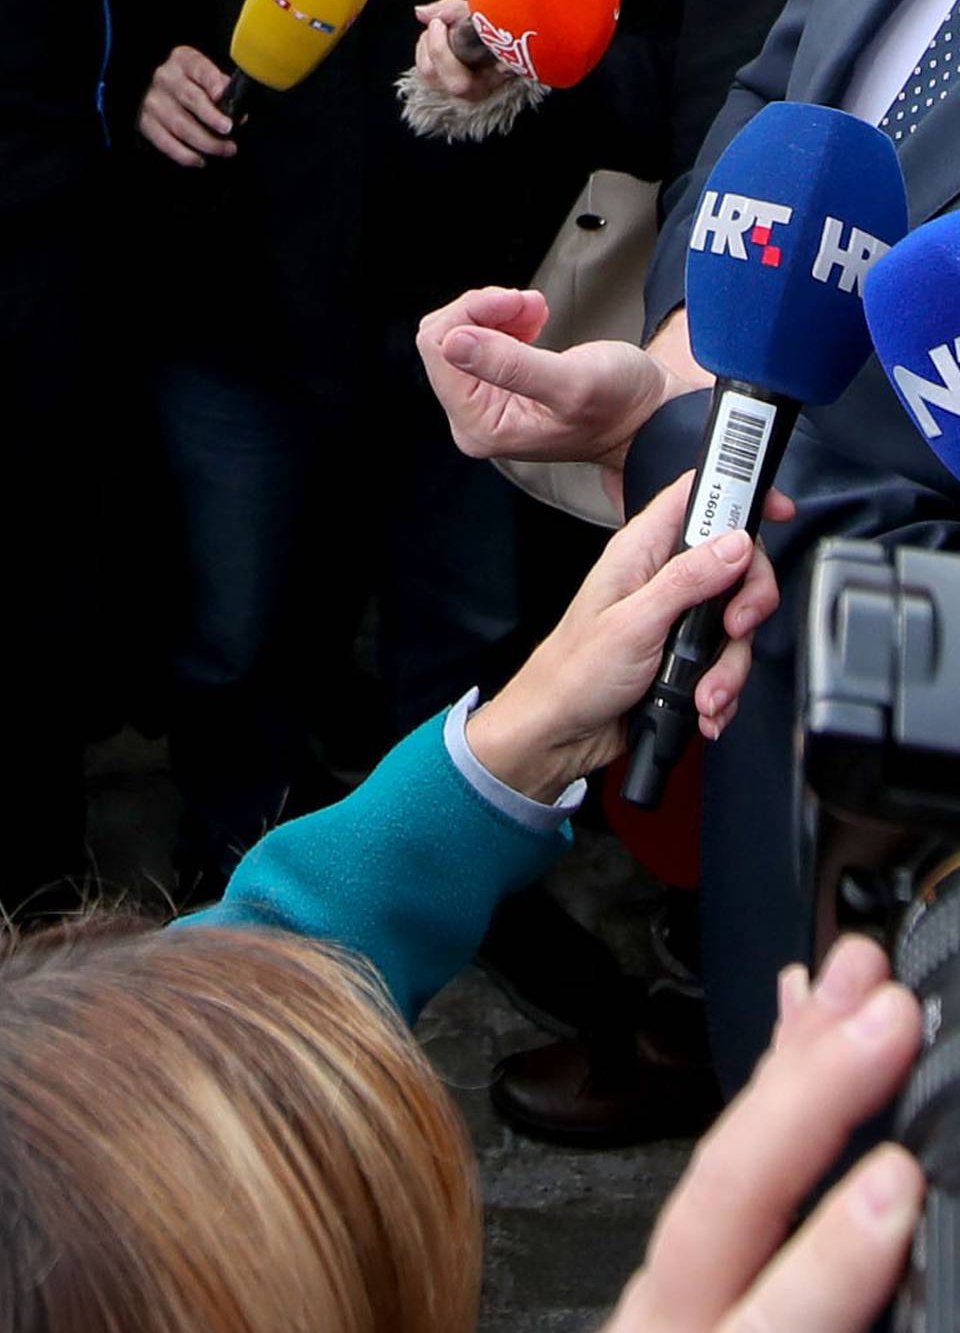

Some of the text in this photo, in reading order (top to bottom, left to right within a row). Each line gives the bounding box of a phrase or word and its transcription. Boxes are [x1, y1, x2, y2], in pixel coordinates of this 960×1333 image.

[690, 190, 793, 266] HRT
[811, 215, 893, 302] HR
[893, 334, 960, 439] N
[699, 483, 722, 537] 136013
